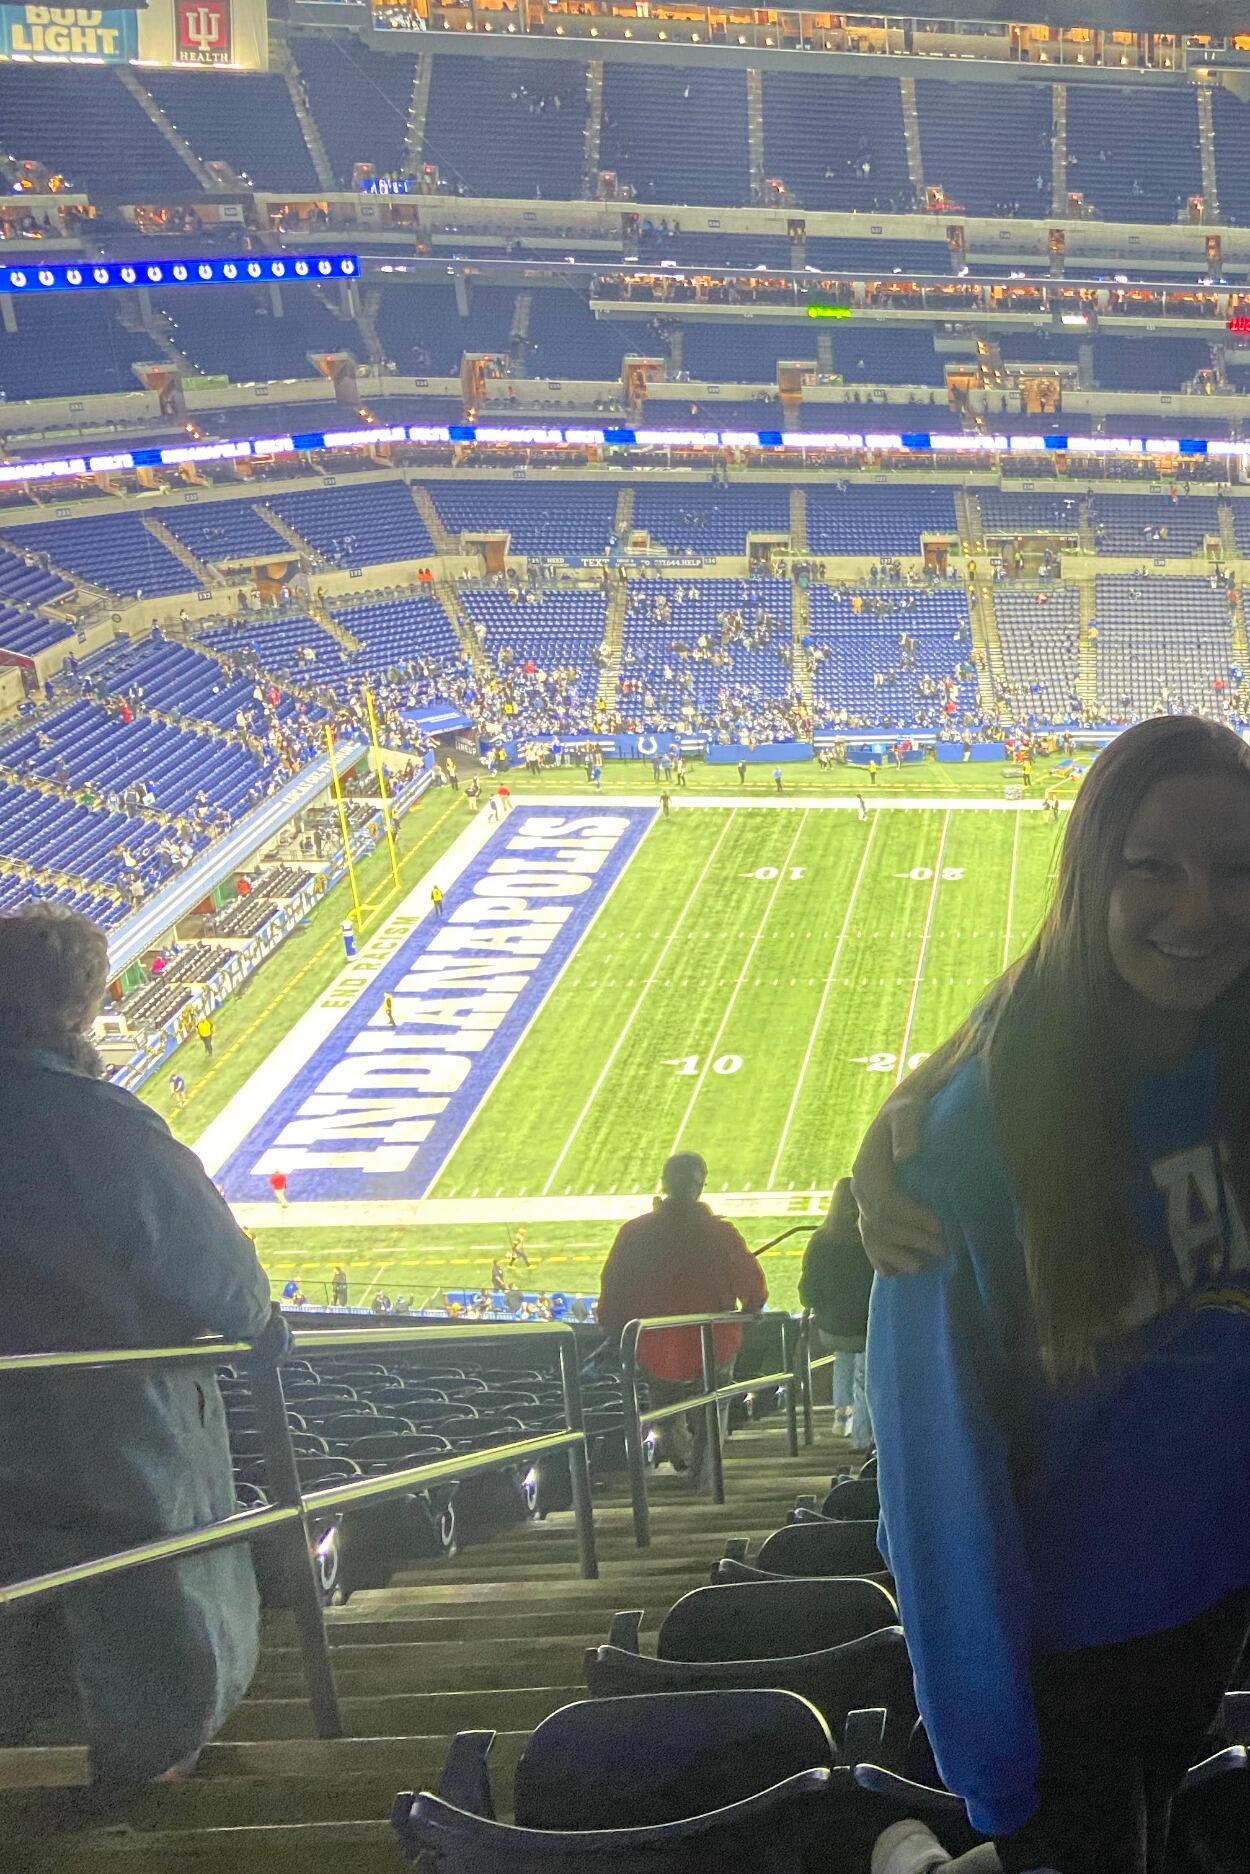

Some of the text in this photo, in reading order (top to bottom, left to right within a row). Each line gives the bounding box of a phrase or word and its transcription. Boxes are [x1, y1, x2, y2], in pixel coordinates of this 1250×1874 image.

[12, 24, 118, 54] LIGHT
[180, 51, 229, 62] HEALTH
[581, 558, 610, 567] TEXT
[320, 916, 420, 1007] END RACISM
[250, 817, 631, 1174] INDIANAPOLIS
[675, 1054, 743, 1076] 10
